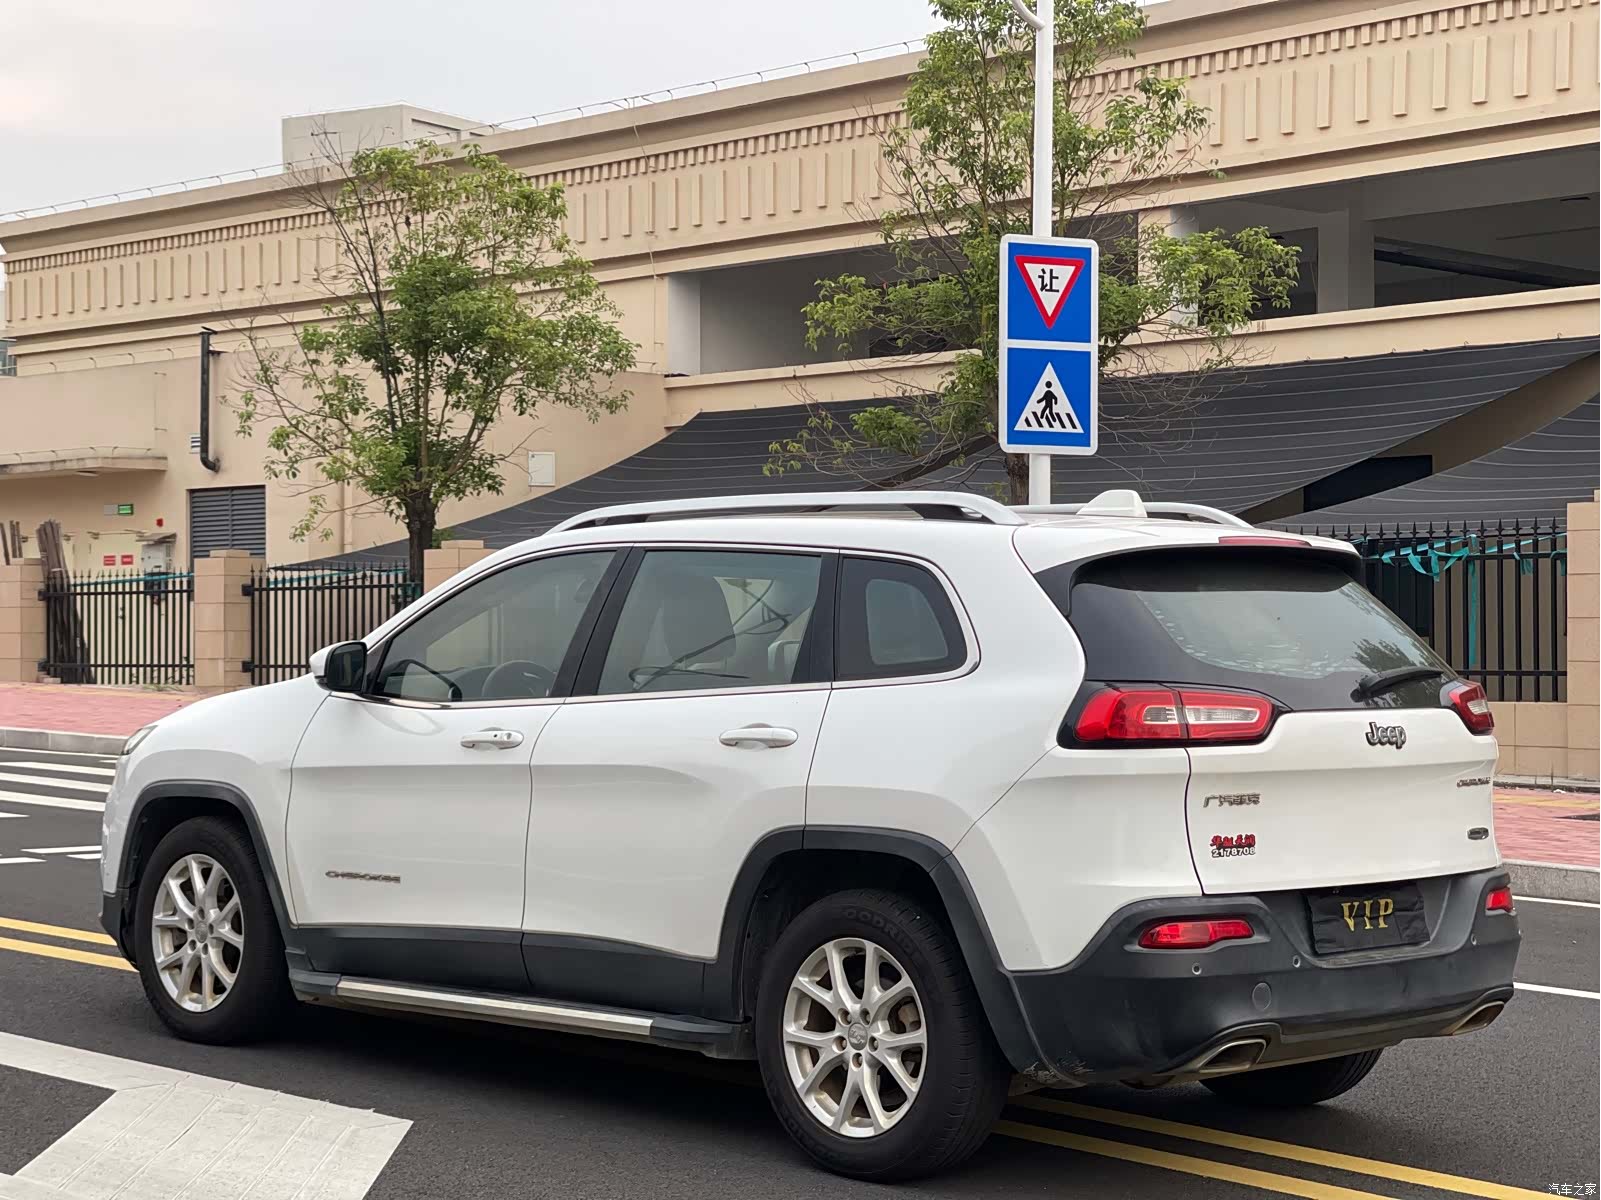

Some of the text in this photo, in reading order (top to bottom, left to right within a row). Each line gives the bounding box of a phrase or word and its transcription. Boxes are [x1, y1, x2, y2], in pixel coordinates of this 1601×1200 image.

[1038, 268, 1060, 293] 让
[1365, 721, 1407, 750] Jeep
[1211, 846, 1256, 858] 2178708
[1341, 898, 1394, 932] VIP
